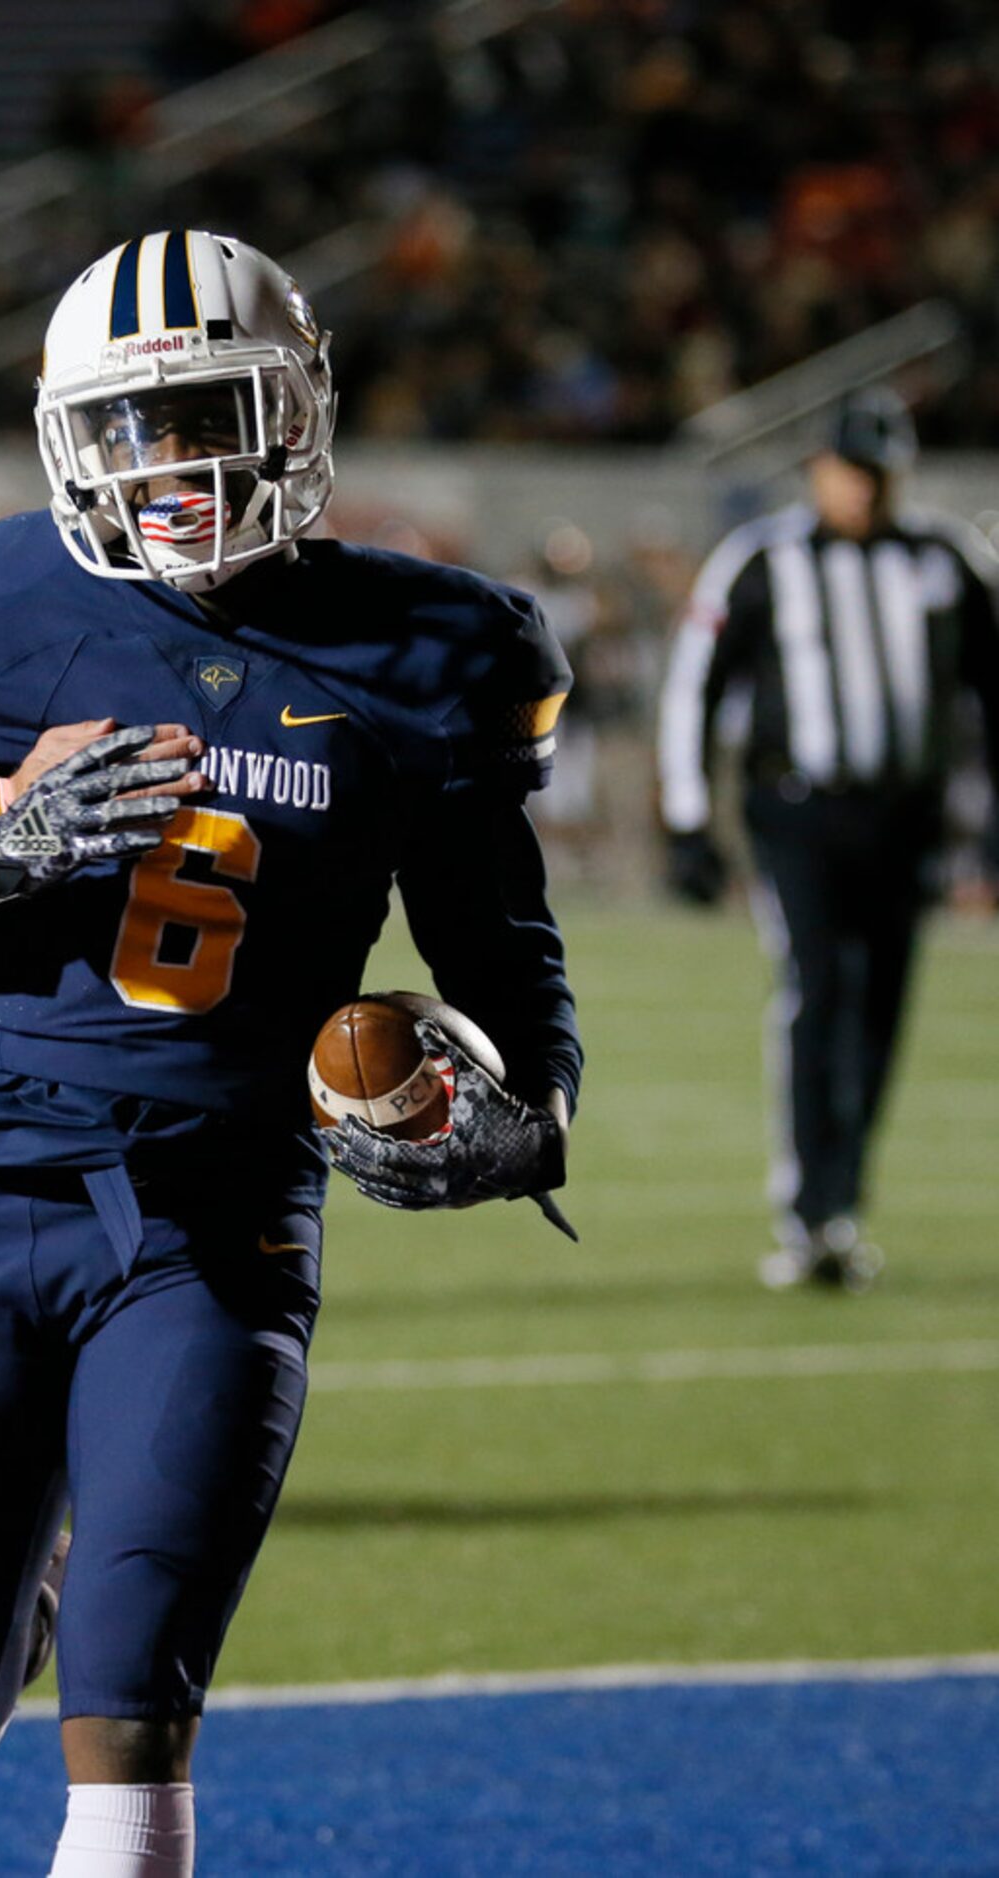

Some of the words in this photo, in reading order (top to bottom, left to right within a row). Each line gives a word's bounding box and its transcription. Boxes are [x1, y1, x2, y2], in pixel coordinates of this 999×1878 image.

[124, 335, 184, 357] Riddell
[201, 745, 331, 811] ONWOOD
[109, 806, 262, 1014] 6
